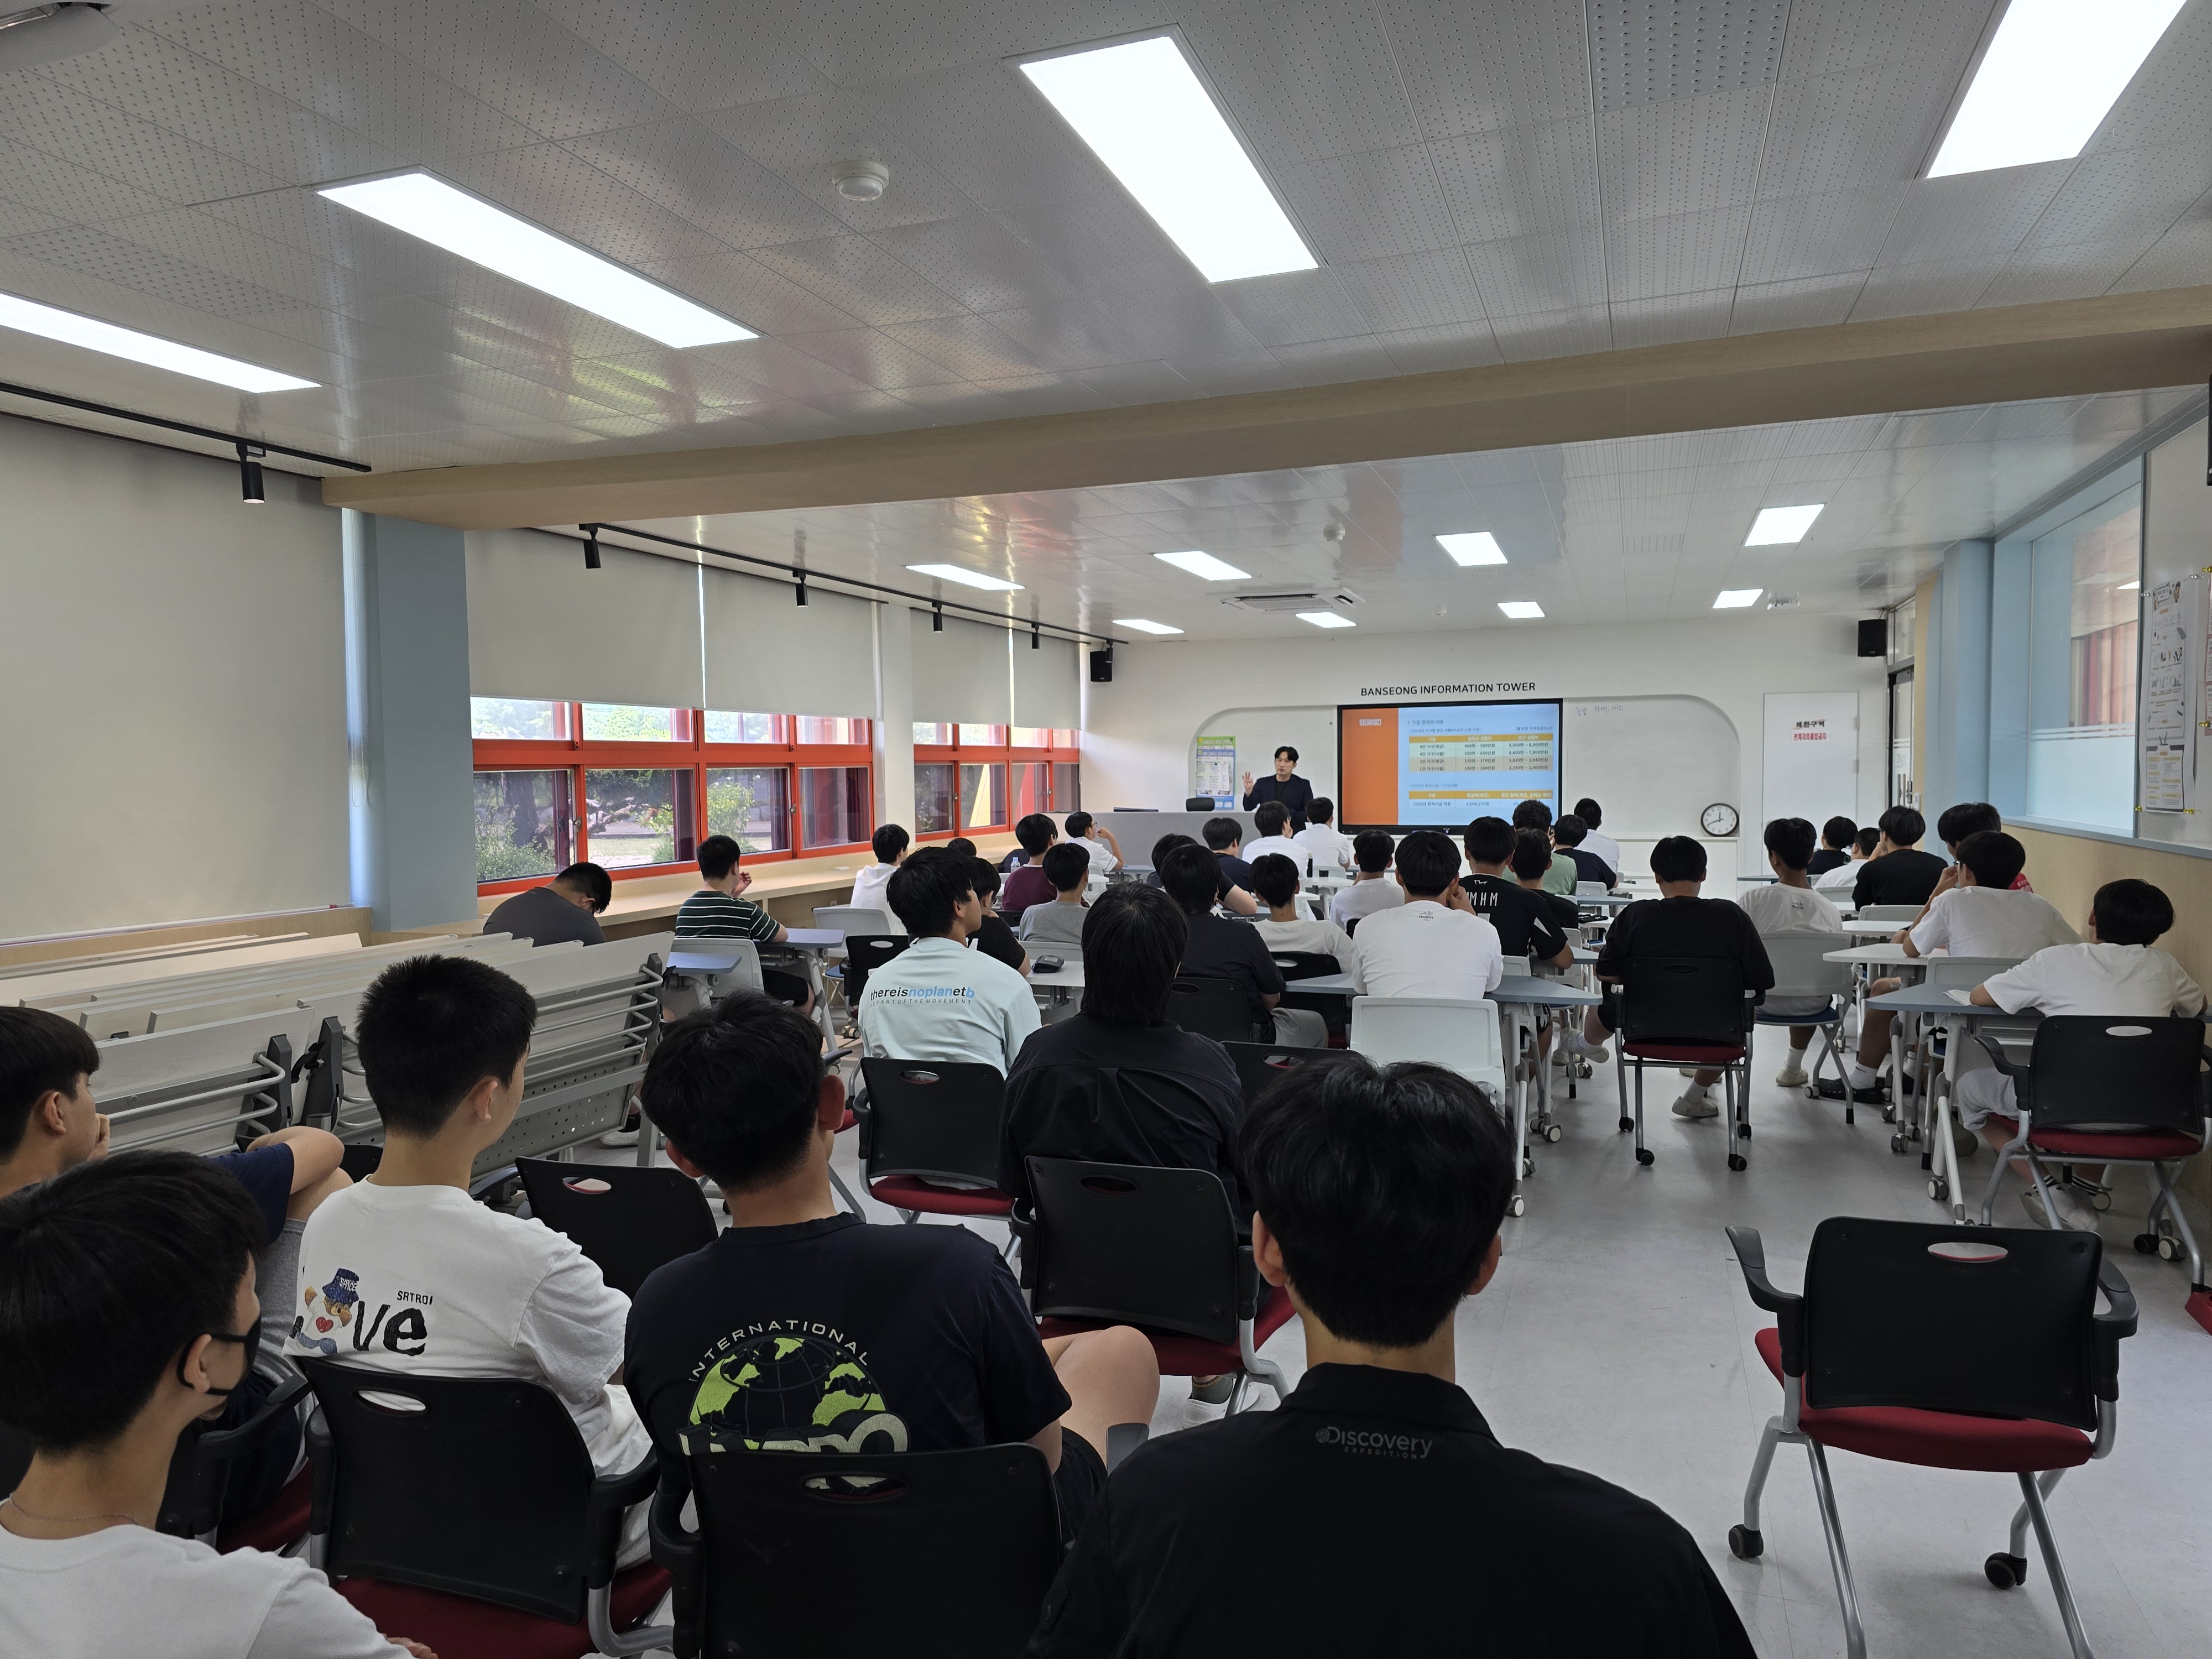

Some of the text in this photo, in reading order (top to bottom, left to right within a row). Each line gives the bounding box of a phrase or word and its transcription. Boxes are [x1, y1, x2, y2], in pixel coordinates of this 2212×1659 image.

[1361, 682, 1536, 696] BANSEONG INFORMATION TOWER
[1467, 891, 1498, 906] MHM
[870, 985, 975, 1001] thereisnoplanetb
[688, 1319, 868, 1382] INTERNATIONAL
[1344, 1446, 1417, 1459] EXPEDITION
